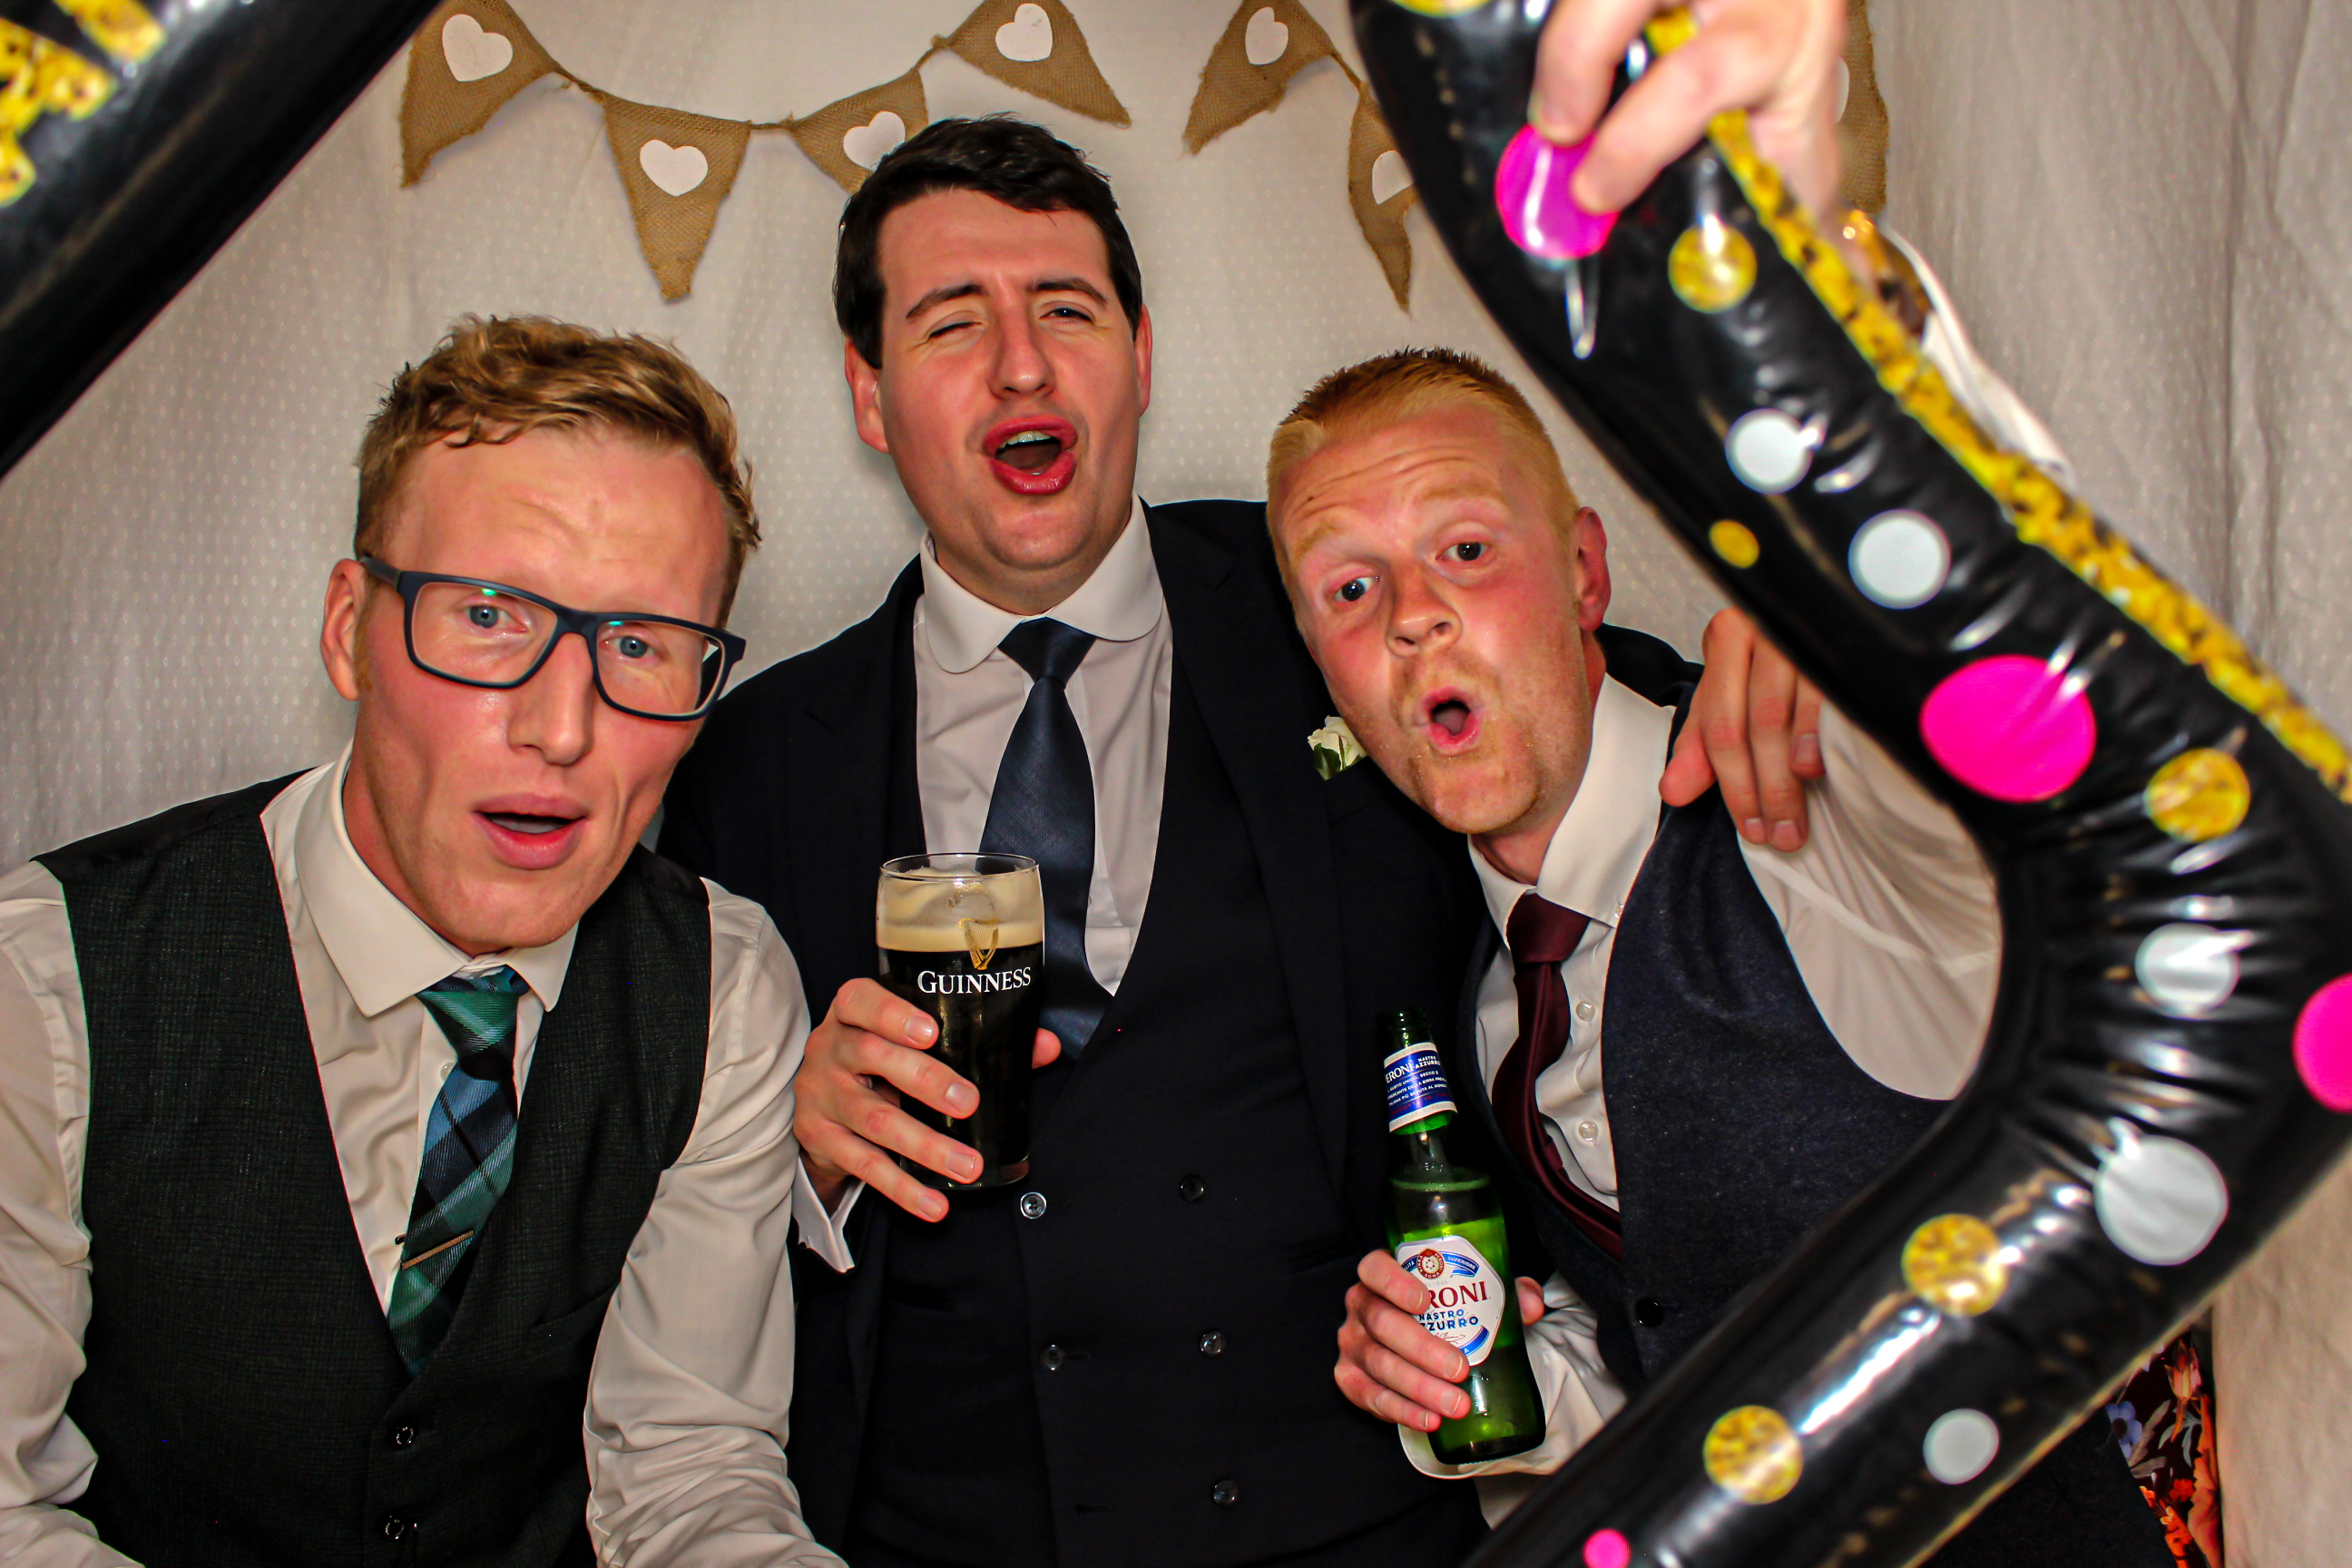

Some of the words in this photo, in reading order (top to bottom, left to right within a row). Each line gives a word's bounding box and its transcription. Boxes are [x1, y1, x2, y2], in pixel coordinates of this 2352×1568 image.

[917, 966, 1031, 995] GUINNESS
[1385, 1063, 1414, 1083] ERONI
[1447, 1256, 1476, 1270] SUPERIORE
[1428, 1280, 1488, 1308] RONI
[1418, 1308, 1465, 1321] NASTRO
[1419, 1316, 1479, 1331] ZURRO
